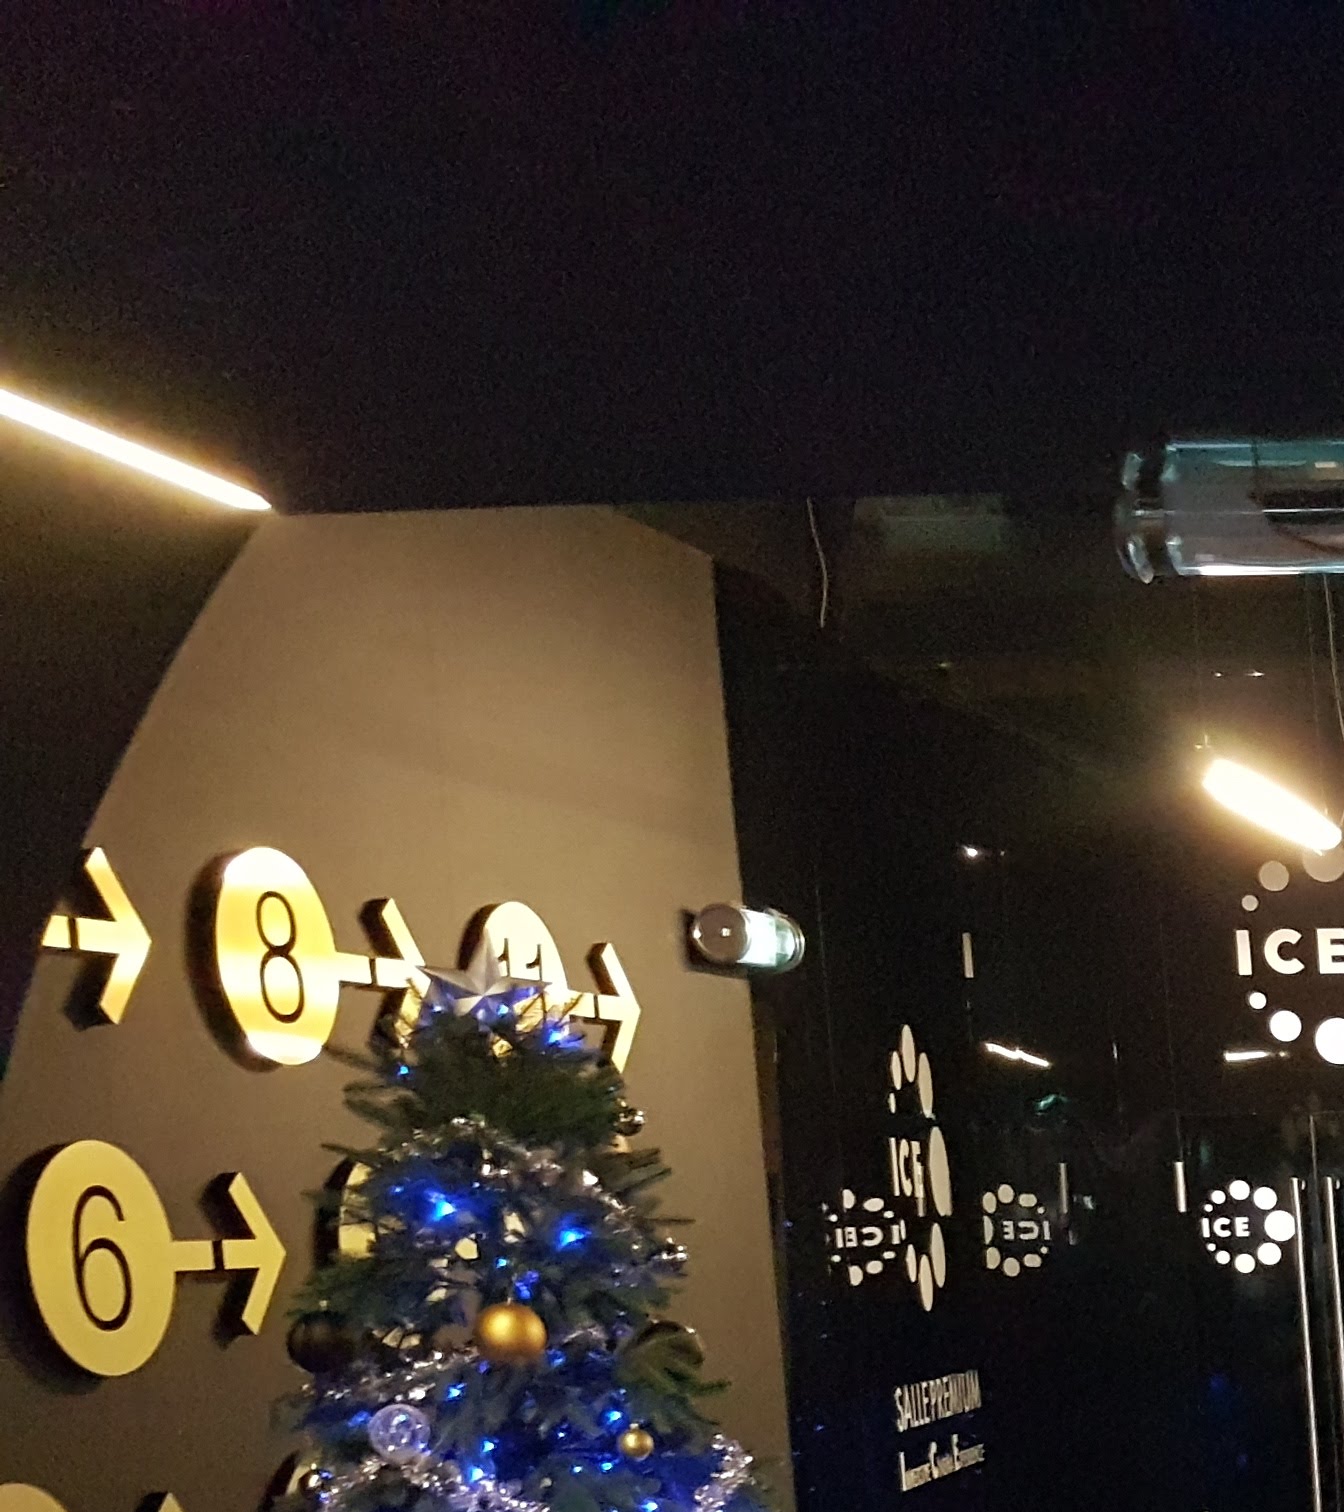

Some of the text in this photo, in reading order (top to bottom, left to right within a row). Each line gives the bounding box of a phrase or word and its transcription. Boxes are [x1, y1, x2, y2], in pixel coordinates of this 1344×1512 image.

[255, 891, 306, 1024] 8
[889, 1137, 926, 1206] ICE
[72, 1185, 133, 1331] 6
[1202, 1216, 1251, 1239] ICE
